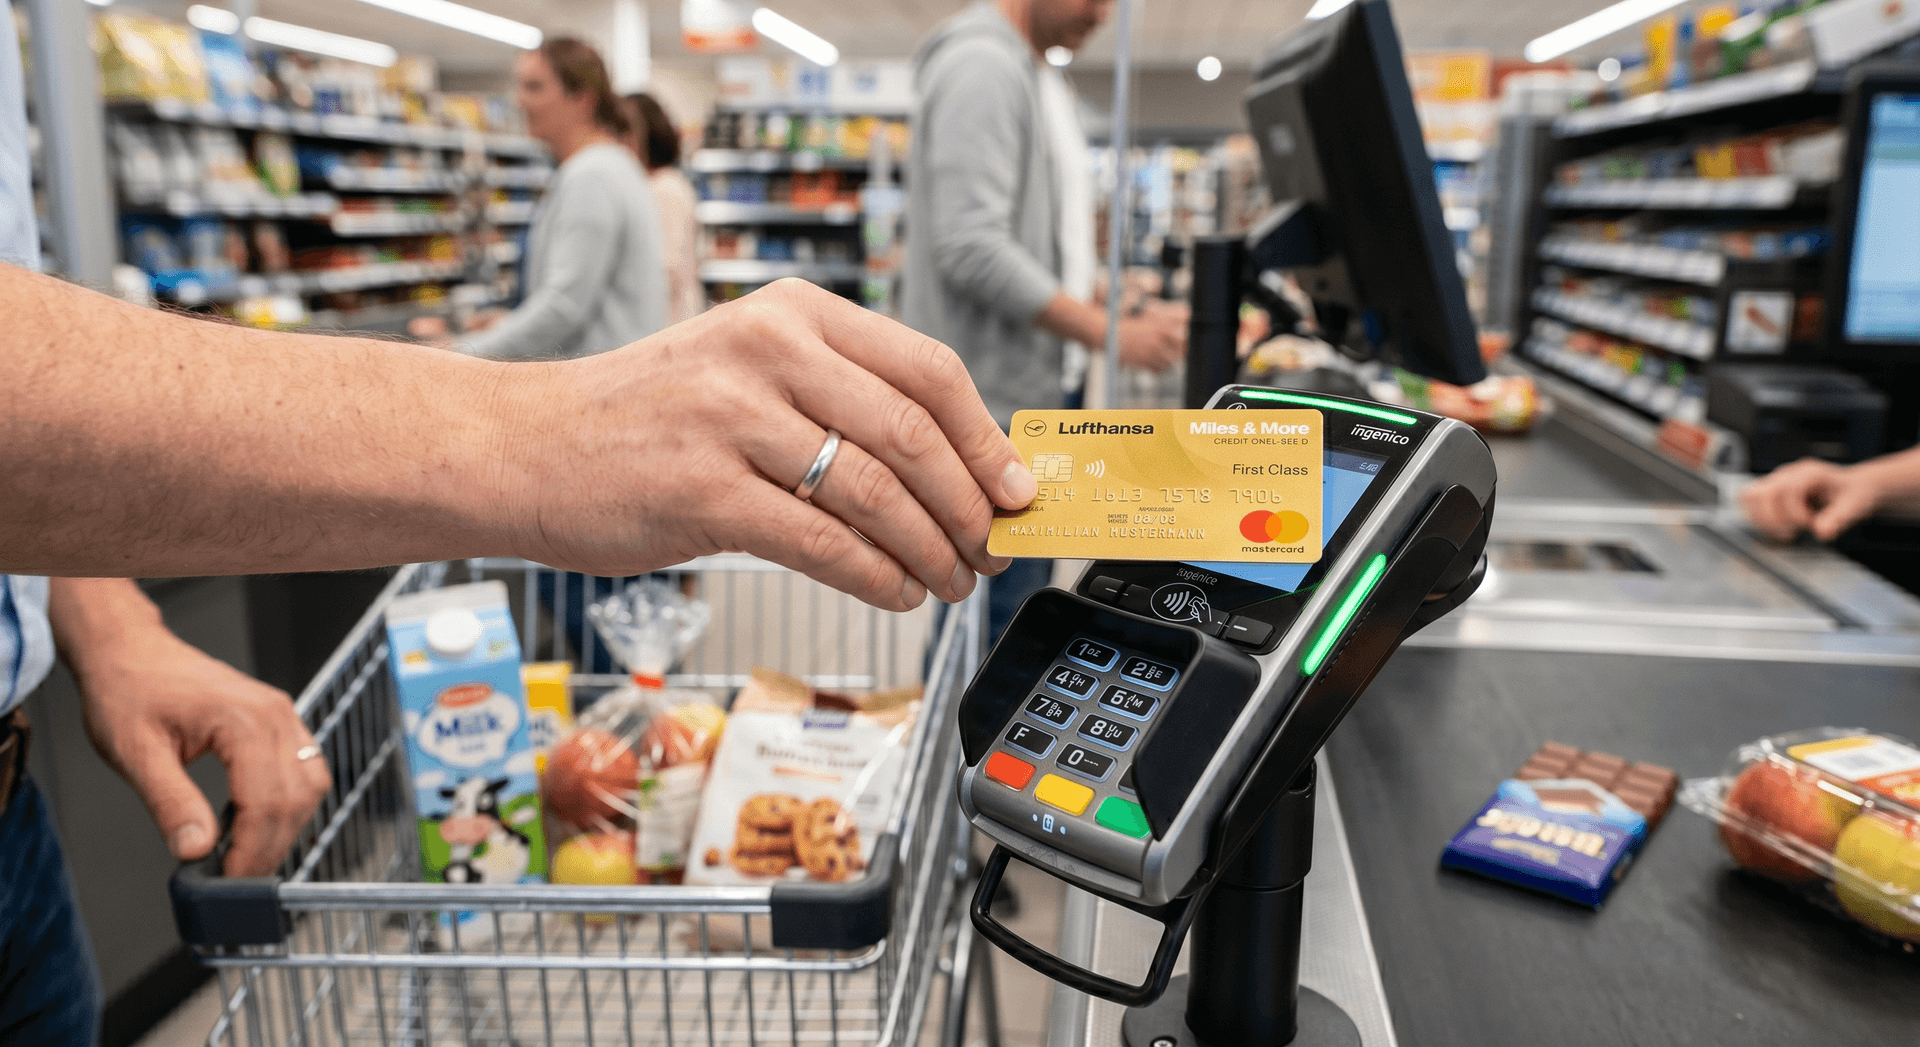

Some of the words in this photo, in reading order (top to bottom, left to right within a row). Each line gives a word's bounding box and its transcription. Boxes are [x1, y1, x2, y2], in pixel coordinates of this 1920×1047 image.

[1058, 421, 1154, 435] Lufthansa
[1189, 421, 1239, 435] Miles
[1242, 421, 1257, 435] &
[1260, 421, 1310, 435] More
[1350, 423, 1409, 445] ingenico
[1232, 463, 1264, 476] First
[1268, 463, 1308, 476] Class
[1037, 486, 1076, 501] 514
[1091, 487, 1143, 502] 1613
[1158, 487, 1212, 503] 7578
[1228, 488, 1282, 504] 7906
[1009, 525, 1100, 537] MAXIMILIAN
[1109, 527, 1205, 539] MUSTERMANN
[1241, 545, 1304, 553] mastercard
[1079, 643, 1089, 656] 1
[1131, 662, 1147, 677] 2
[1055, 670, 1071, 685] 4
[1035, 697, 1051, 712] 7
[1013, 727, 1030, 740] F
[1090, 720, 1107, 735] 8
